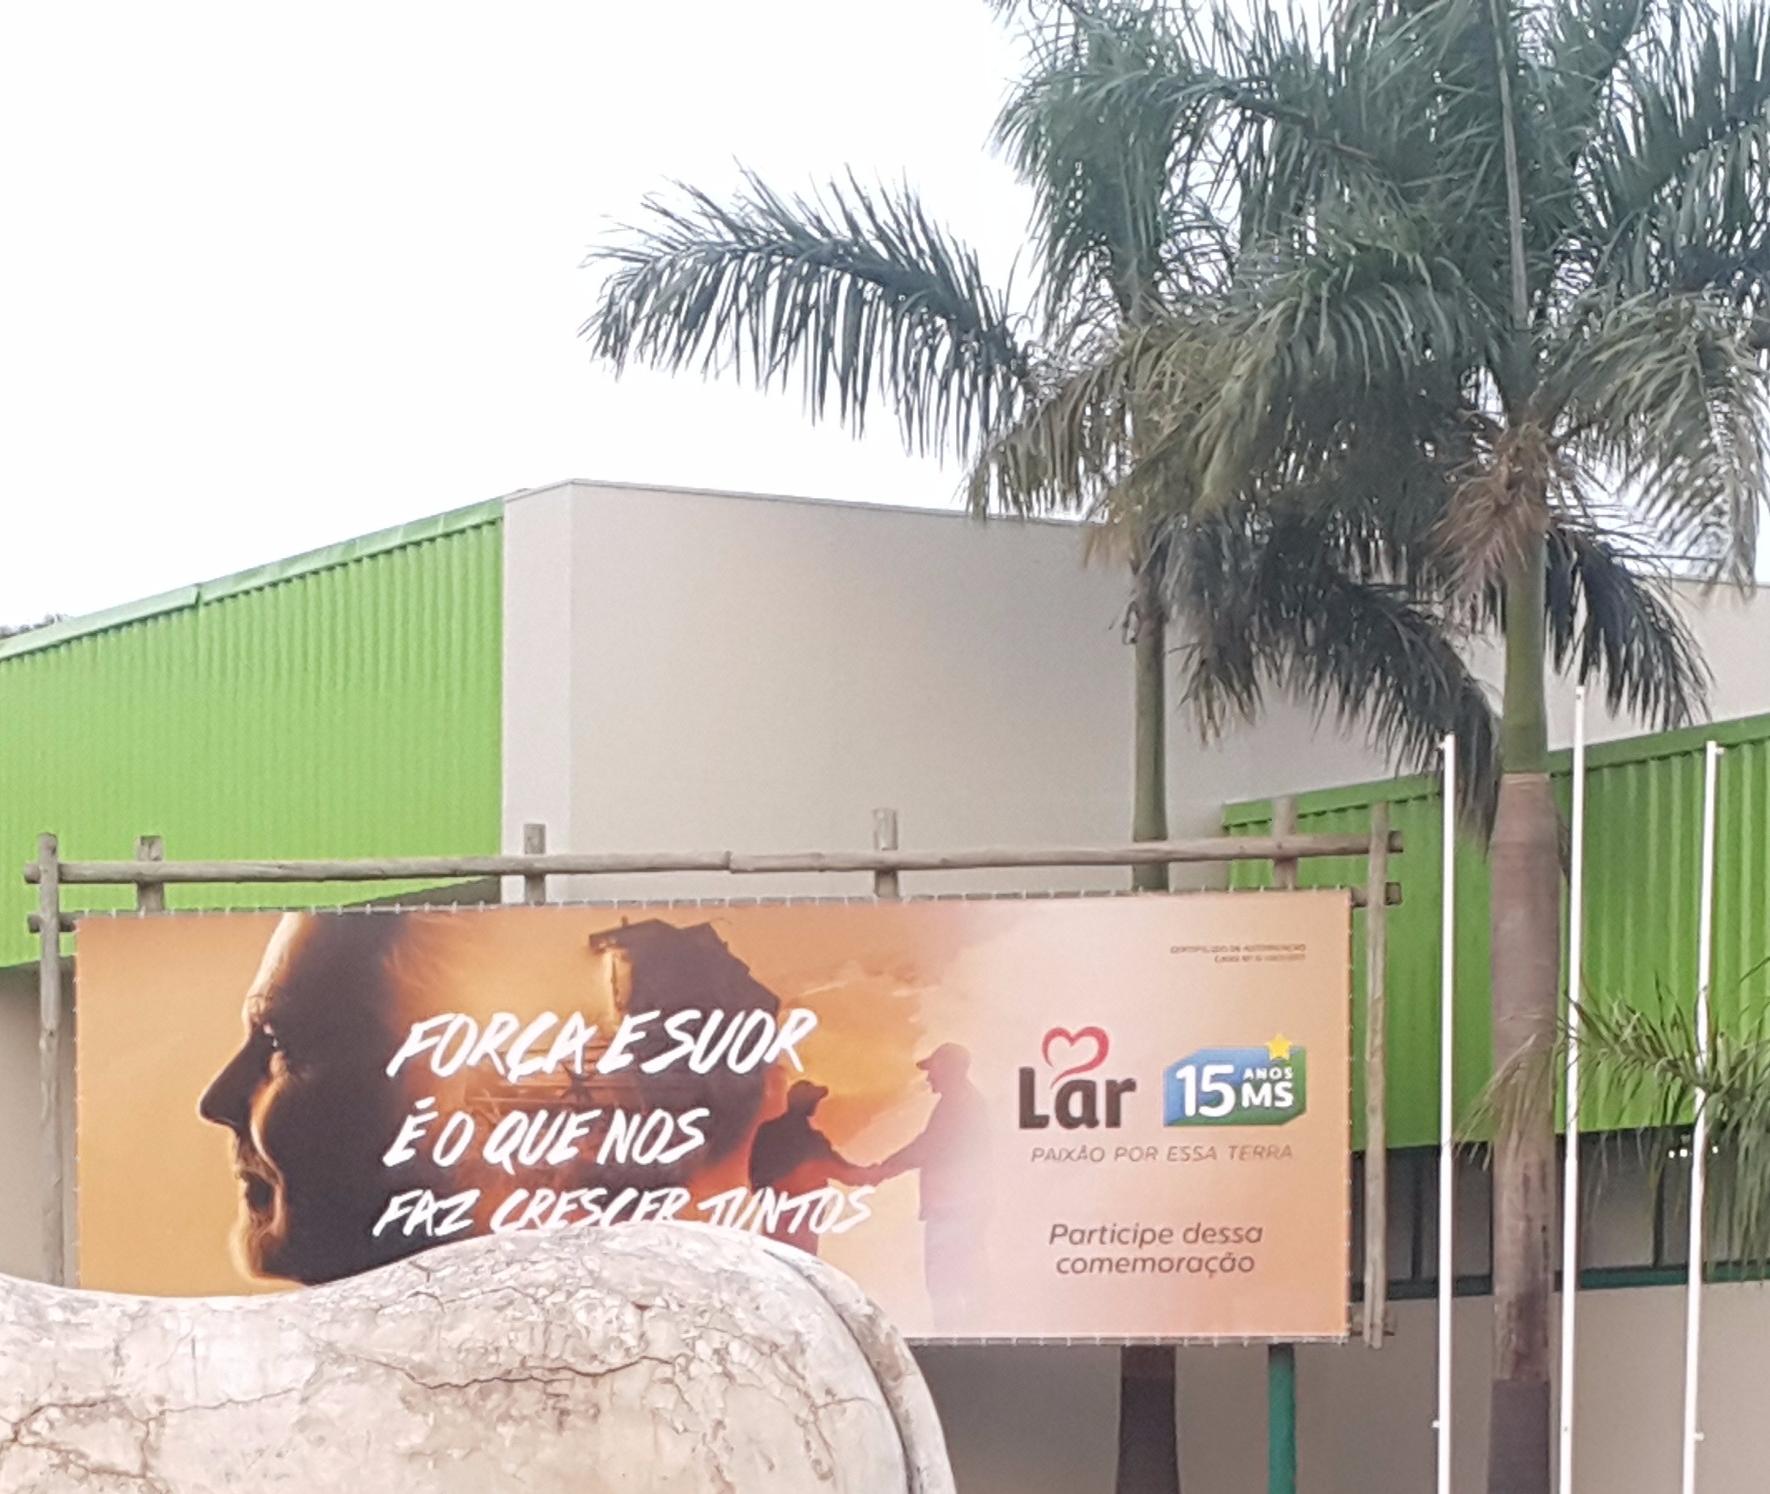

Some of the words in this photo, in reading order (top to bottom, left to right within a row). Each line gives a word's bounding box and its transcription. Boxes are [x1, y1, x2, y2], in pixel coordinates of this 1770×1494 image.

[386, 1010, 600, 1084] FORÇA
[596, 1010, 663, 1075] E
[641, 1008, 819, 1076] SUOR
[1175, 1063, 1236, 1118] 15
[1242, 1066, 1294, 1081] ANOS
[1019, 1066, 1137, 1130] Lar
[1241, 1082, 1295, 1109] MS
[382, 1096, 439, 1168] É
[431, 1110, 476, 1168] O
[482, 1108, 604, 1176] QUE
[595, 1107, 711, 1166] NOS
[1031, 1144, 1106, 1163] PAIXÃO
[1113, 1145, 1159, 1163] POR
[1166, 1145, 1218, 1162] ESSA
[1228, 1144, 1294, 1161] TERRA
[372, 1187, 482, 1238] FAZ
[490, 1186, 691, 1232] CRESCER
[1049, 1222, 1174, 1249] Participe
[1182, 1222, 1264, 1245] dessa
[1056, 1252, 1256, 1278] comemoração
